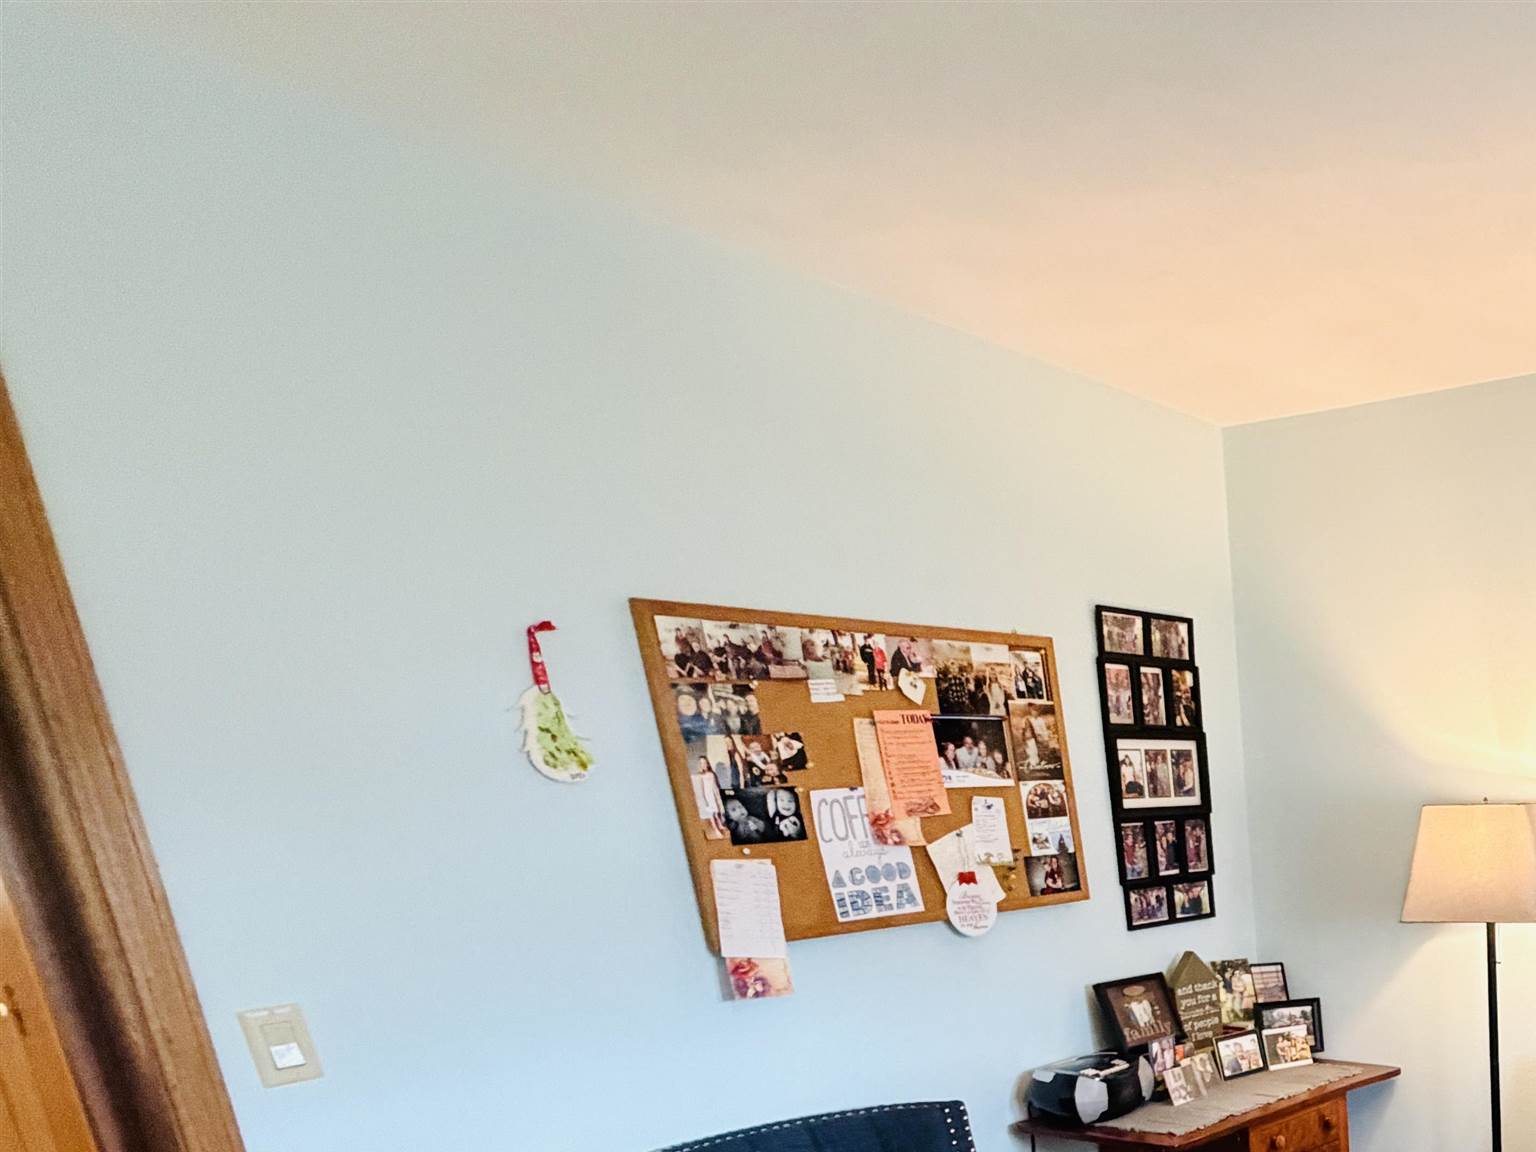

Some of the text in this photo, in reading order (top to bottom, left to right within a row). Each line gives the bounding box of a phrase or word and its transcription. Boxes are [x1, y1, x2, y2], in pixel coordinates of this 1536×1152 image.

[817, 795, 869, 843] COFF
[832, 861, 911, 888] A GOOD
[834, 883, 921, 919] IDEA
